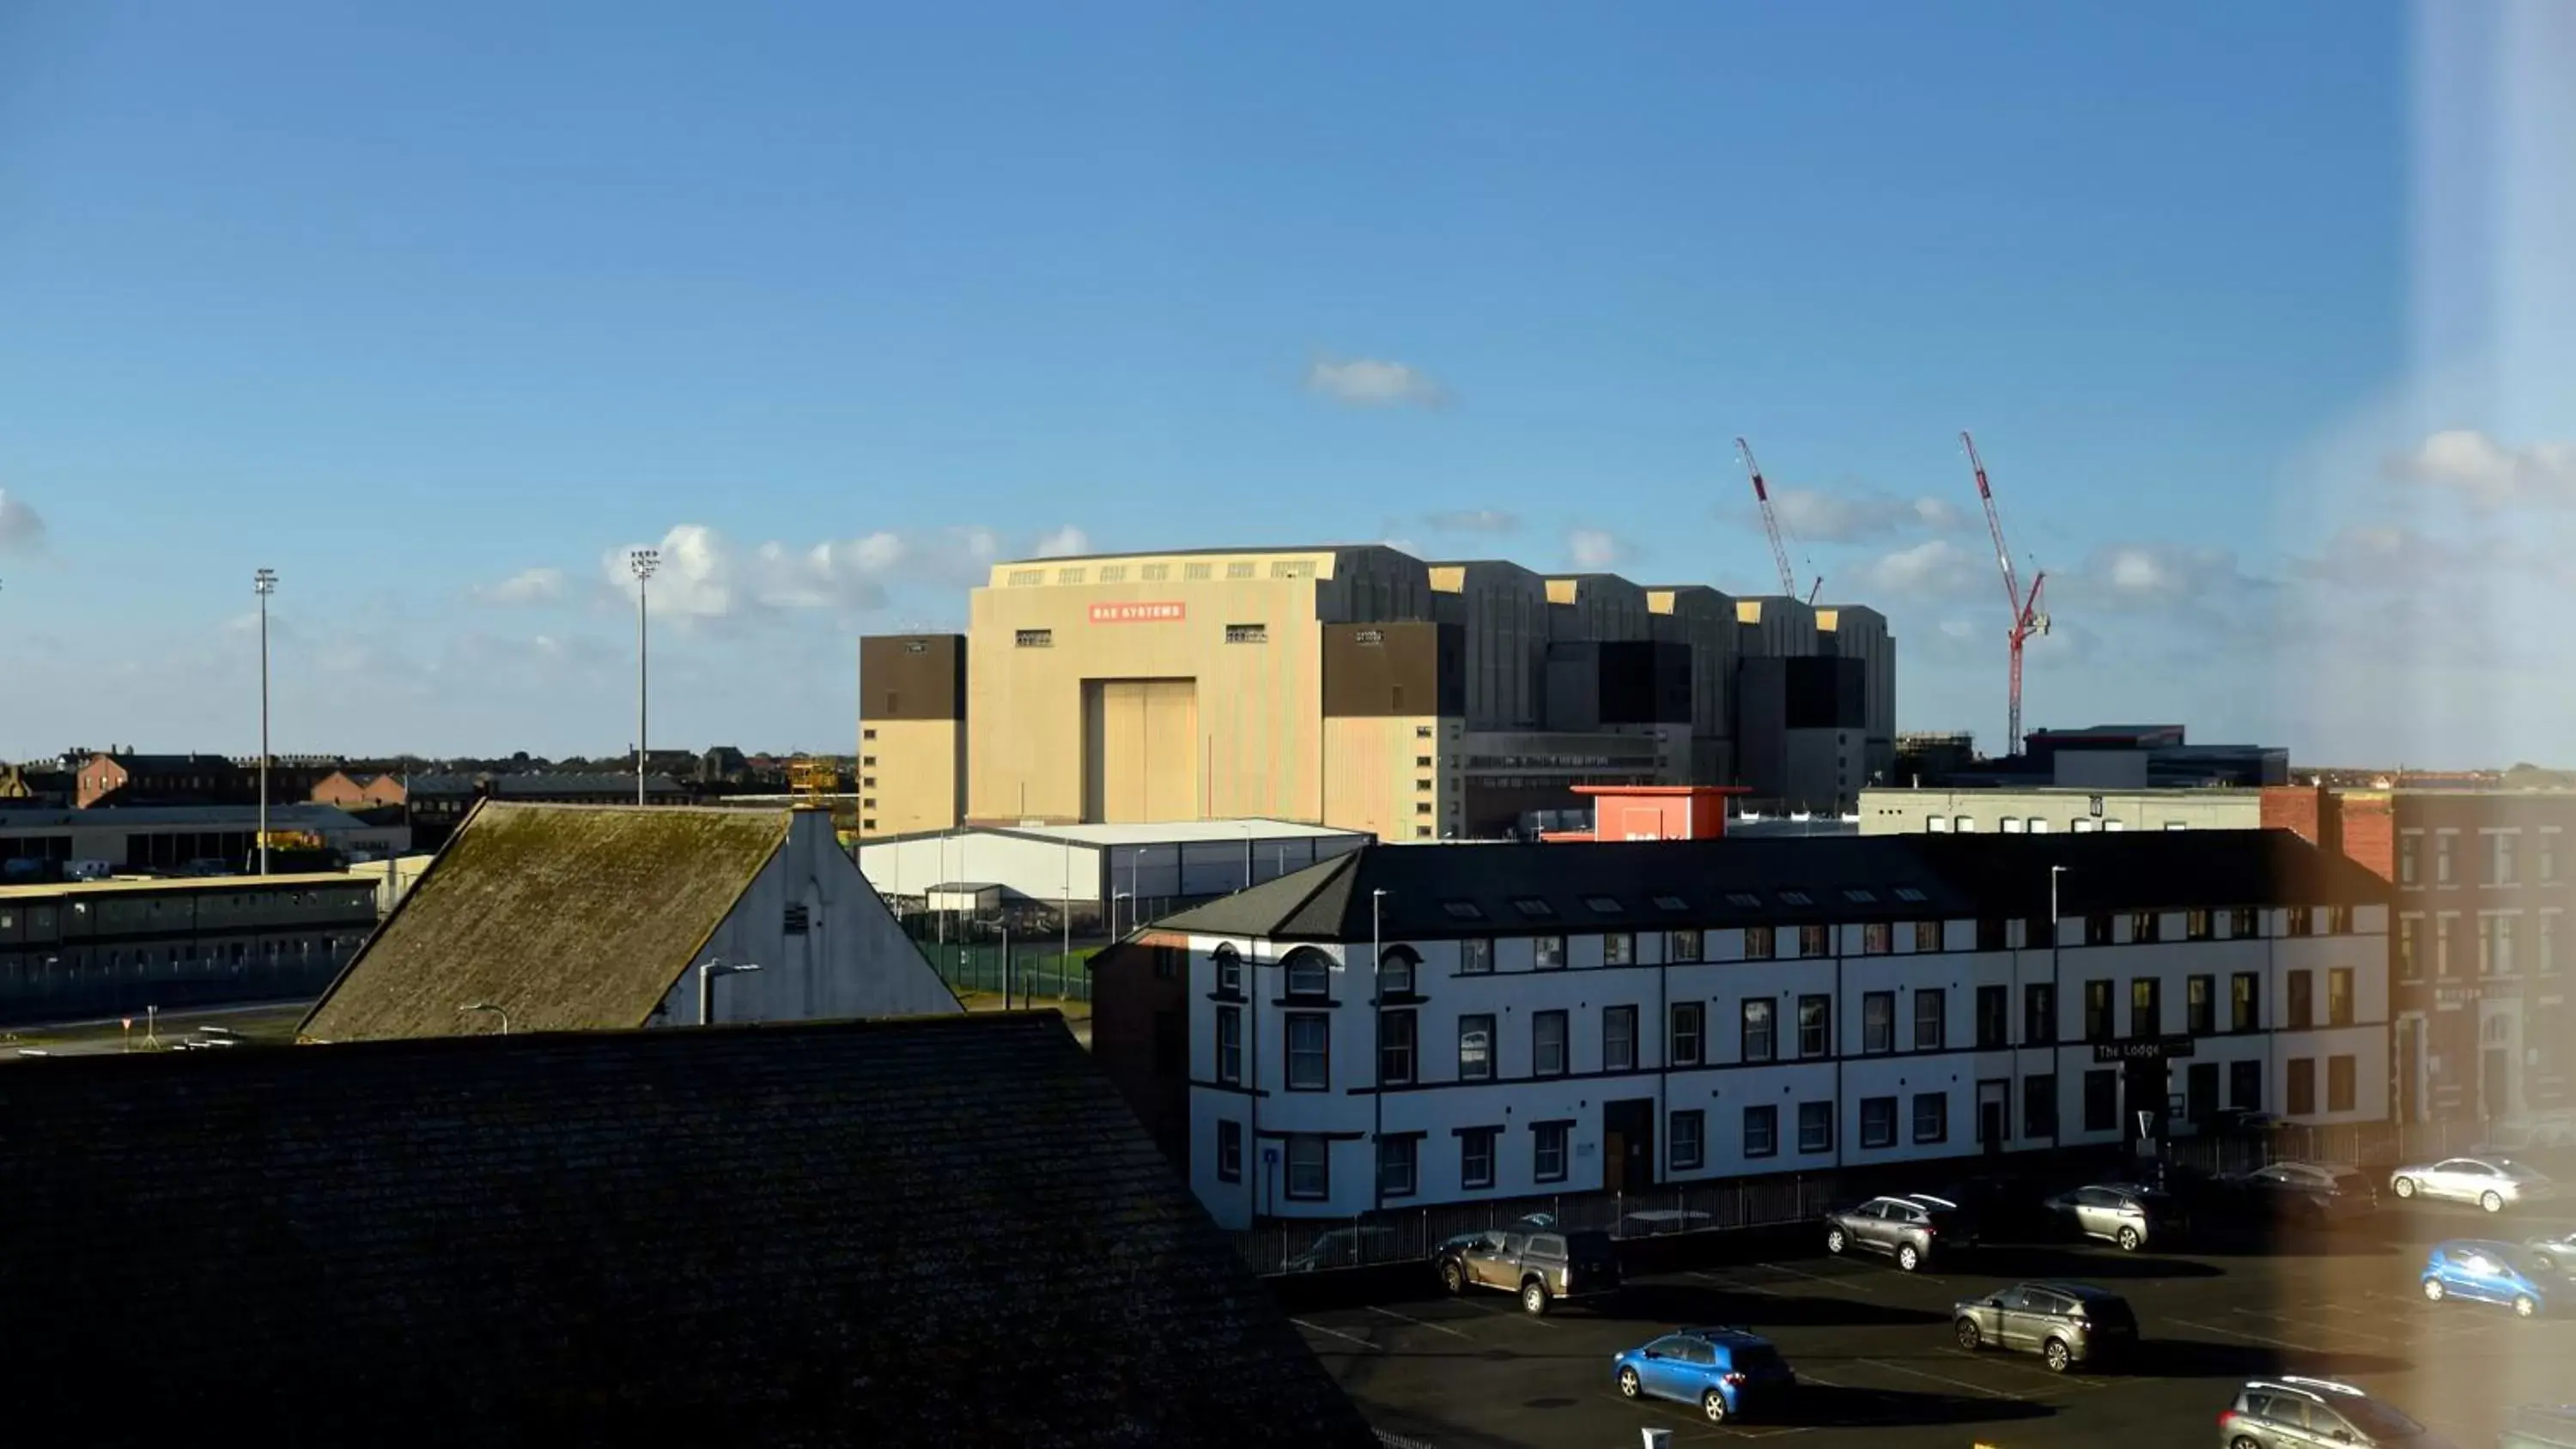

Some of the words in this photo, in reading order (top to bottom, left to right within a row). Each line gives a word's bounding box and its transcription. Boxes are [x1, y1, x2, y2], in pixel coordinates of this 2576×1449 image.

[1093, 608, 1118, 619] BAE
[1121, 605, 1180, 618] SYSTEMS
[2099, 1044, 2119, 1058] The
[2123, 1044, 2160, 1058] Lodge
